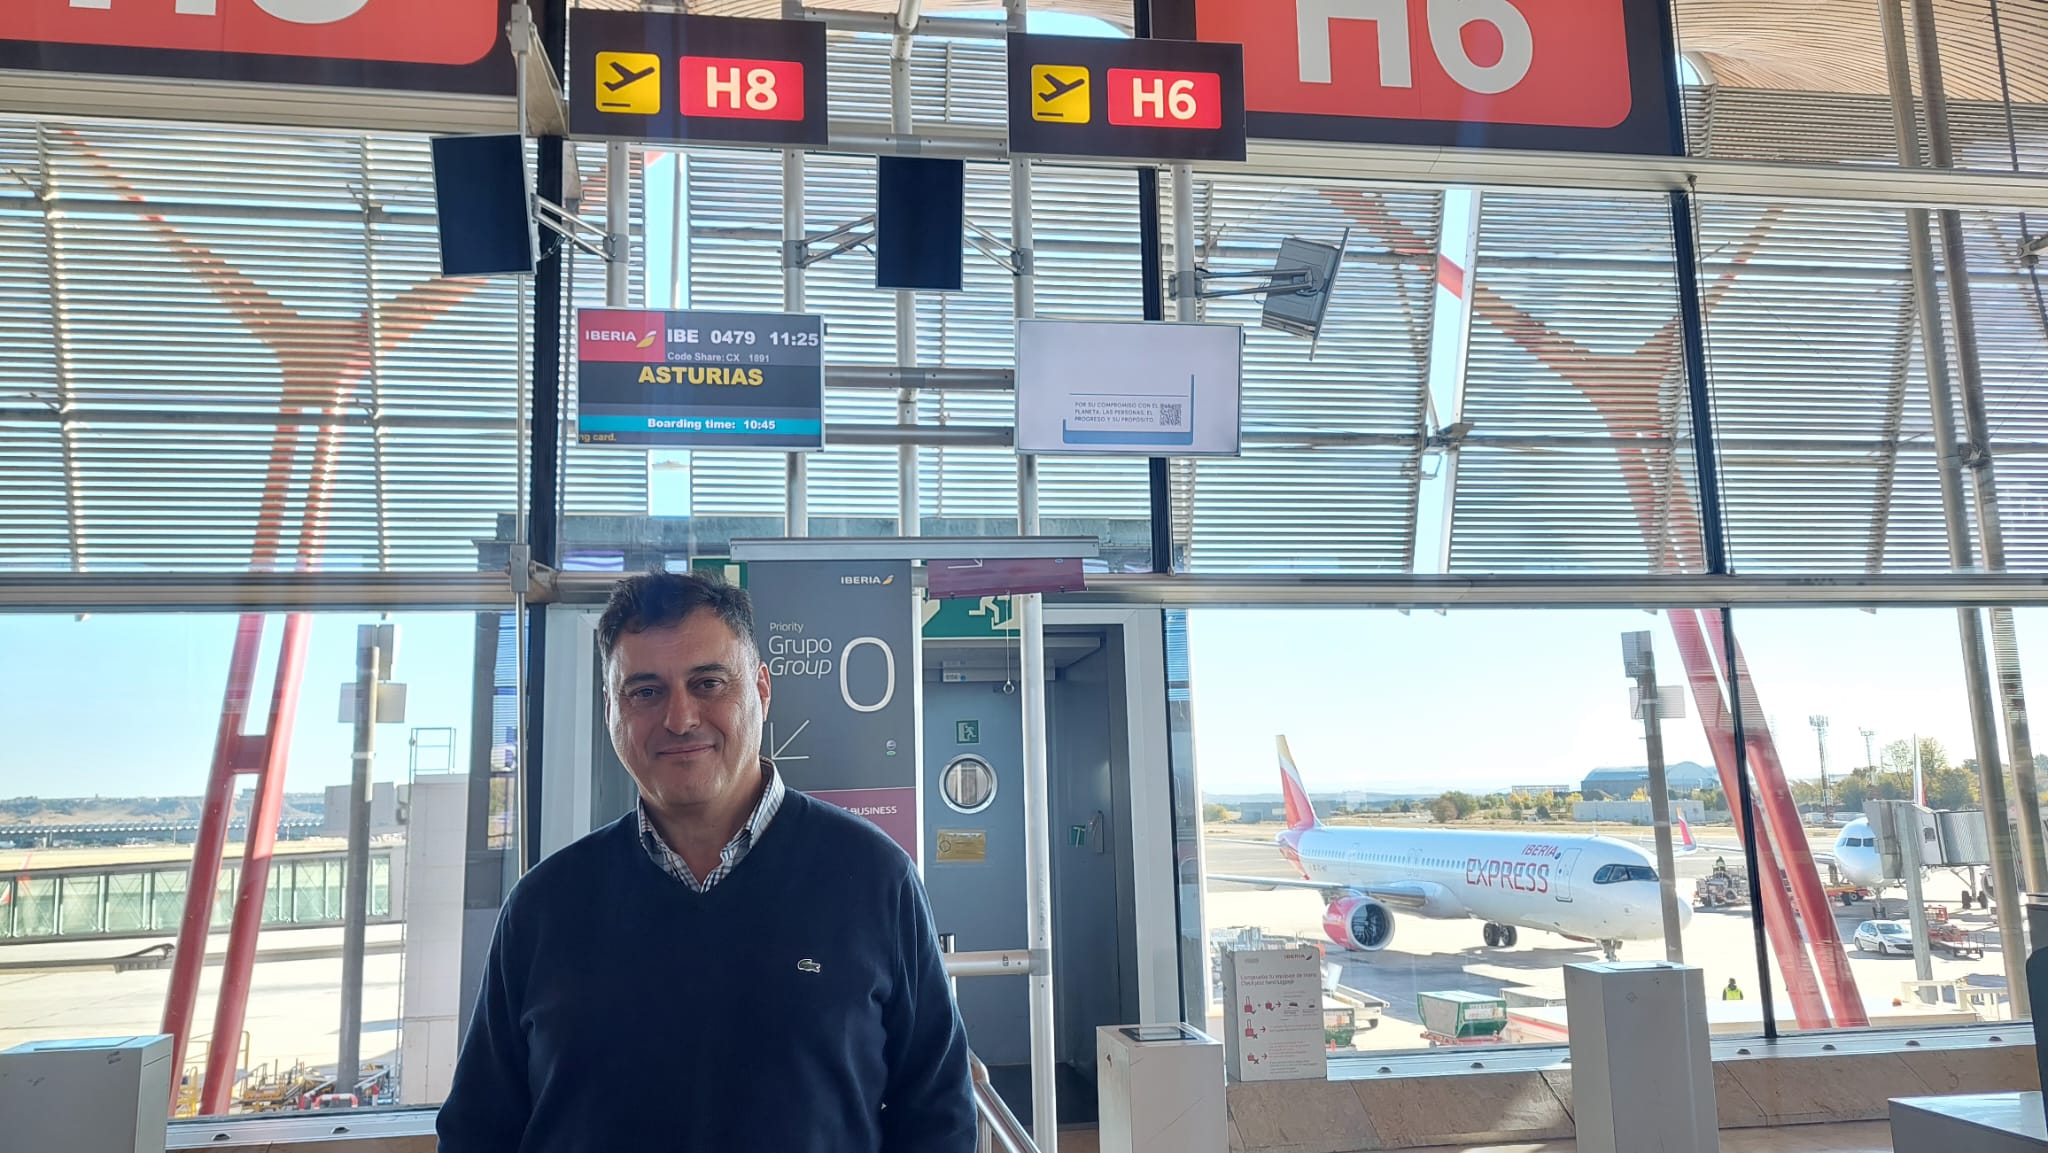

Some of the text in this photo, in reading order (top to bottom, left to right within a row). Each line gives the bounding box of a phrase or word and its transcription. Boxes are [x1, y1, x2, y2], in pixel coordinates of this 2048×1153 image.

[1296, 0, 1533, 95] H6
[706, 65, 779, 111] H8
[1132, 77, 1197, 121] H6
[585, 330, 637, 342] IBERIA
[667, 329, 819, 347] IBE 0479 11:25
[667, 352, 770, 363] Code Share: CX 1891
[638, 366, 764, 386] ASTURIAS
[648, 418, 776, 430] Boarding time: 10:45
[593, 433, 617, 442] card.
[840, 576, 882, 585] IBERIA
[769, 622, 804, 634] Priority
[768, 635, 832, 659] Grupo
[769, 657, 832, 680] Group
[850, 805, 897, 816] BUSINESS
[1521, 844, 1559, 857] IBERIA
[1466, 858, 1549, 894] EXPRESS
